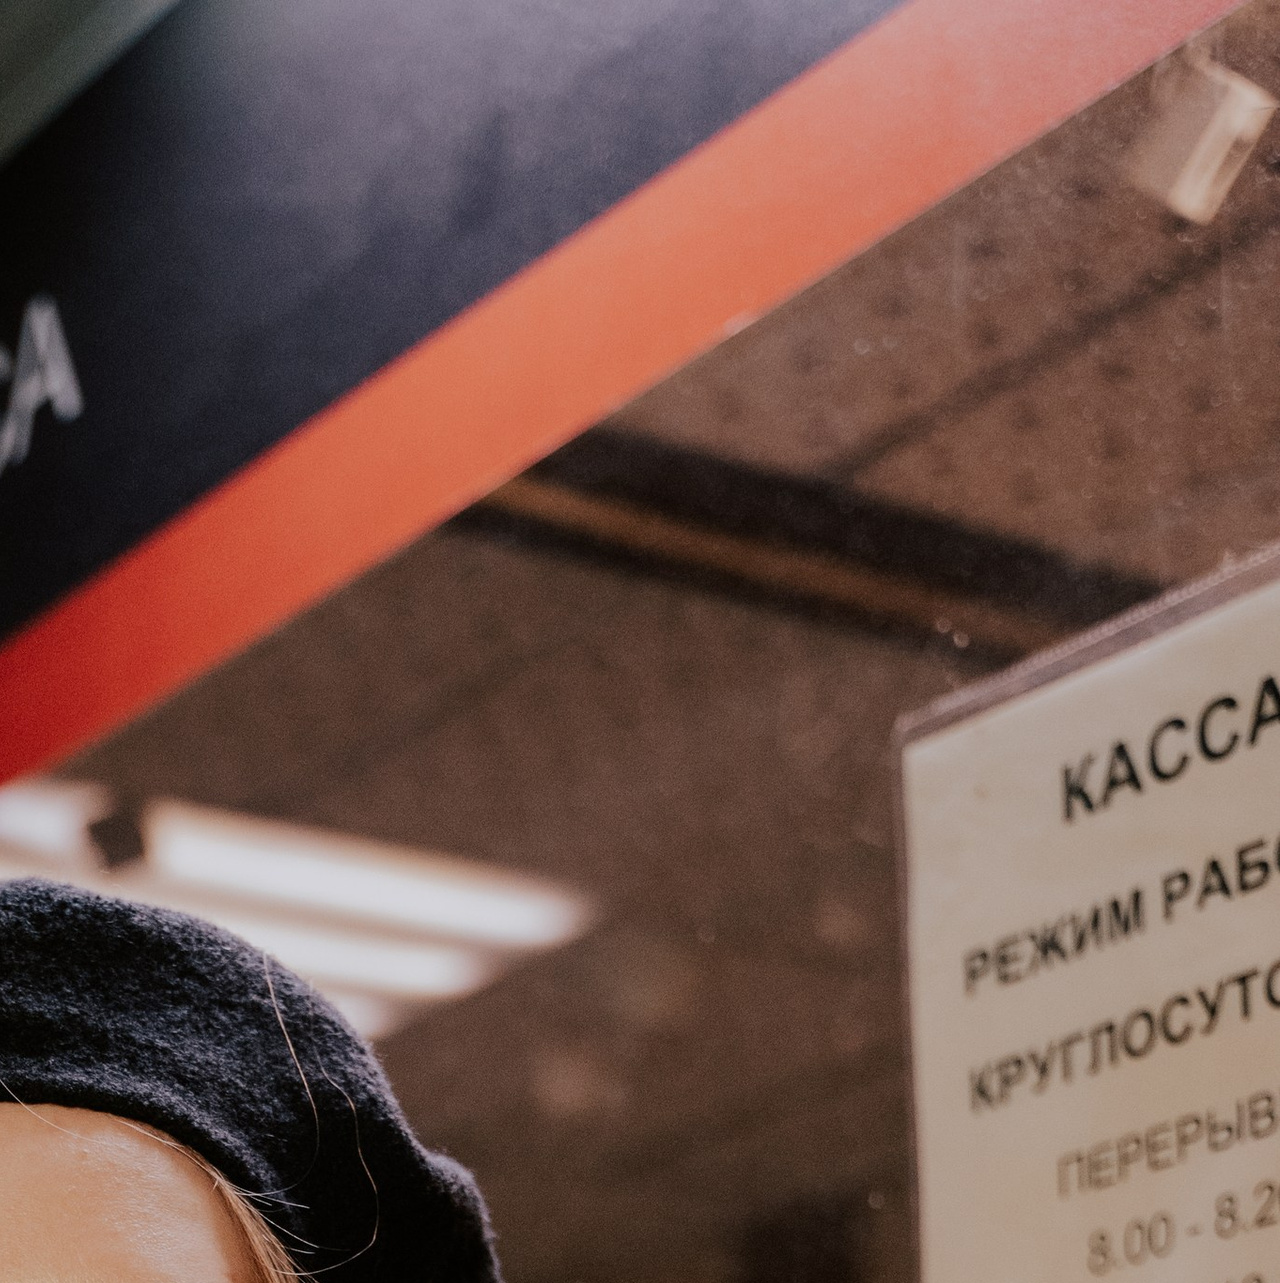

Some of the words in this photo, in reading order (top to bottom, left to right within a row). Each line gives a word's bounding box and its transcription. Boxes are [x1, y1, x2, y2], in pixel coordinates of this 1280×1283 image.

[1062, 675, 1280, 823] КАССА
[961, 884, 1146, 998] РЕЖИМ
[1085, 1208, 1176, 1277] 8.00
[1214, 1177, 1280, 1240] 8.2
